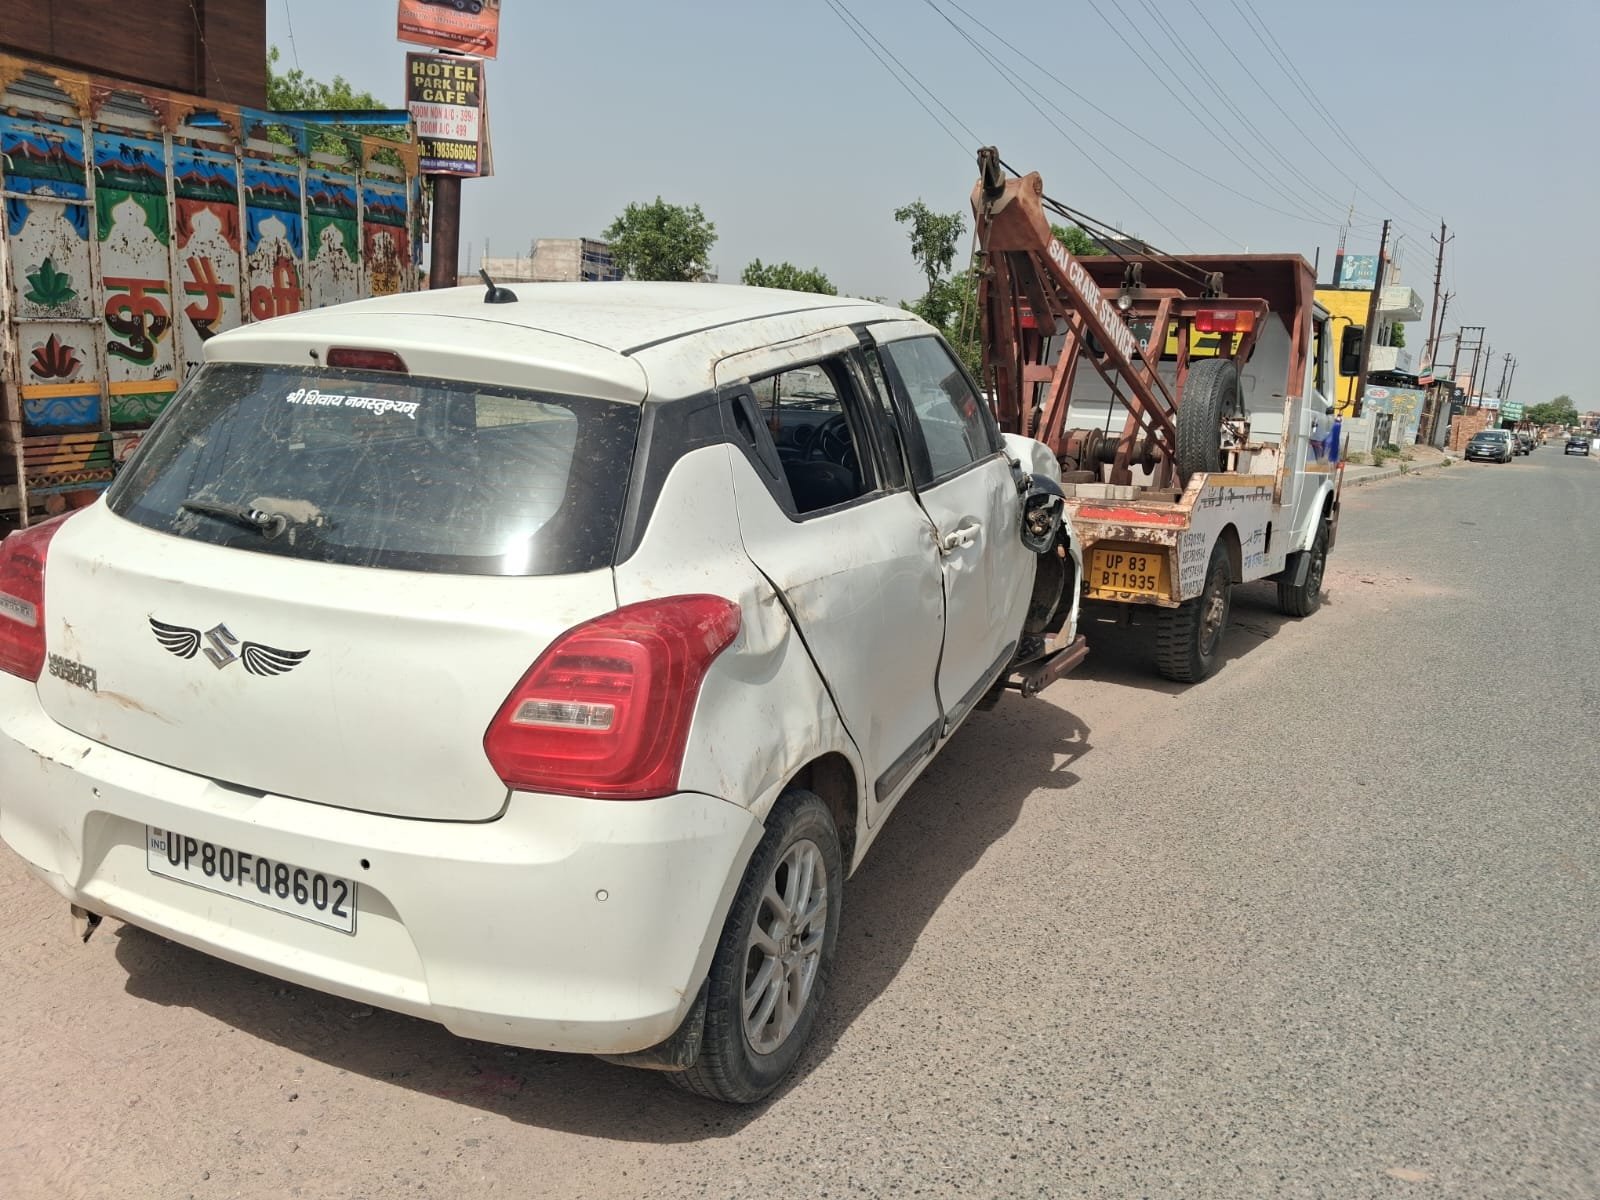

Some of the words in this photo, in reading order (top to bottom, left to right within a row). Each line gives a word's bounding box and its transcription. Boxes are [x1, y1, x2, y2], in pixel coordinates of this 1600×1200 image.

[412, 61, 478, 81] HOTEL
[415, 76, 452, 90] PARK
[422, 89, 466, 104] CAFE
[411, 104, 429, 119] ROOM
[420, 120, 438, 135] ROOM
[286, 388, 305, 404] श्री
[302, 389, 346, 407] शिवाय
[1106, 554, 1123, 569] UP
[1129, 556, 1147, 572] 83
[1102, 571, 1156, 590] BT1935
[151, 838, 166, 851] IND
[166, 830, 349, 919] UP80FQ8602
